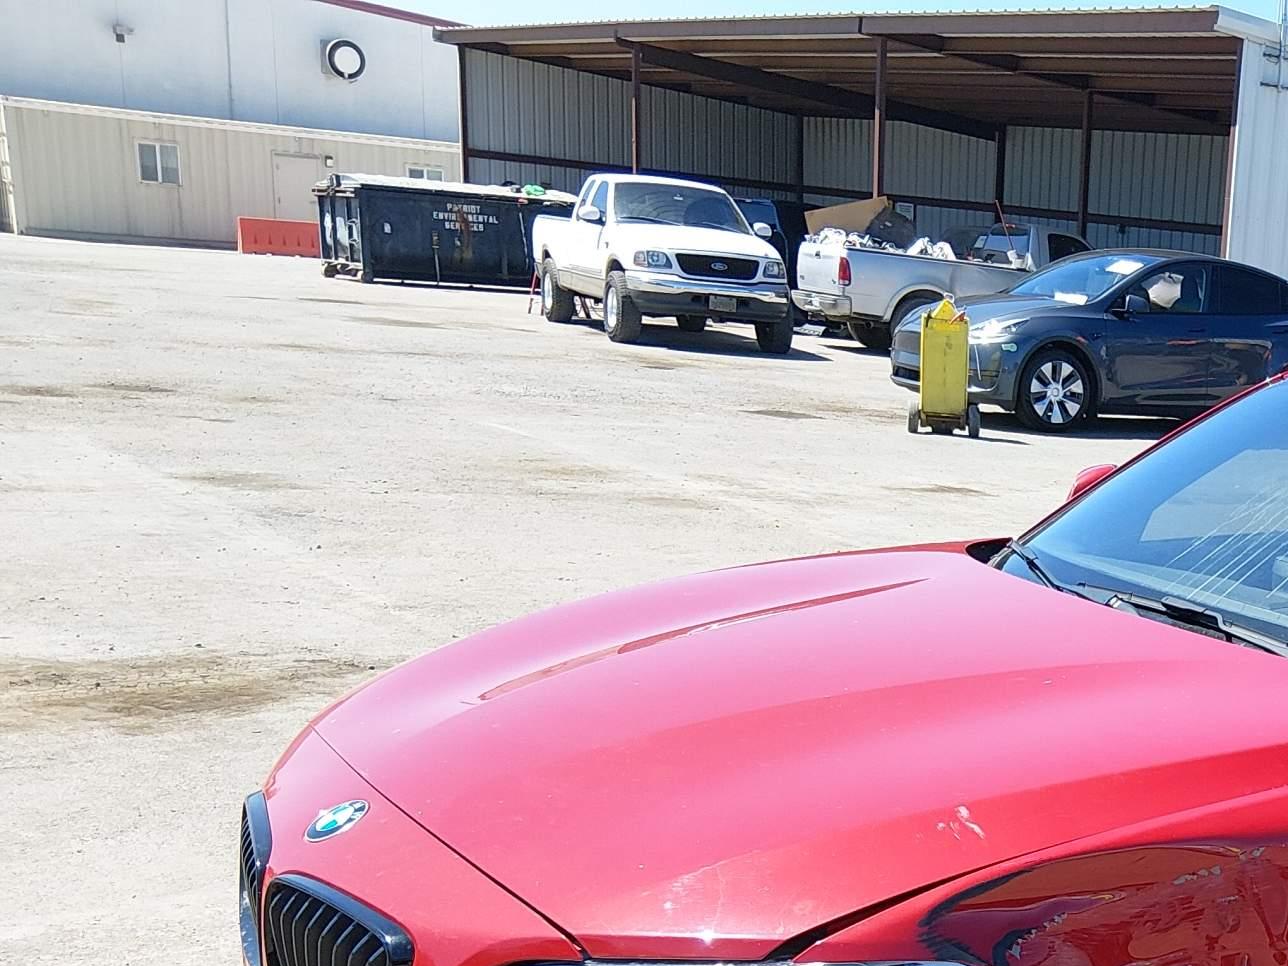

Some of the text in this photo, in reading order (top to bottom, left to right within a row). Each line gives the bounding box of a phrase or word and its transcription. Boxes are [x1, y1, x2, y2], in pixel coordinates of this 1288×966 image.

[446, 203, 481, 214] PATRIOT
[432, 211, 499, 224] ENVIRNMENTAL
[444, 221, 484, 232] SERCES
